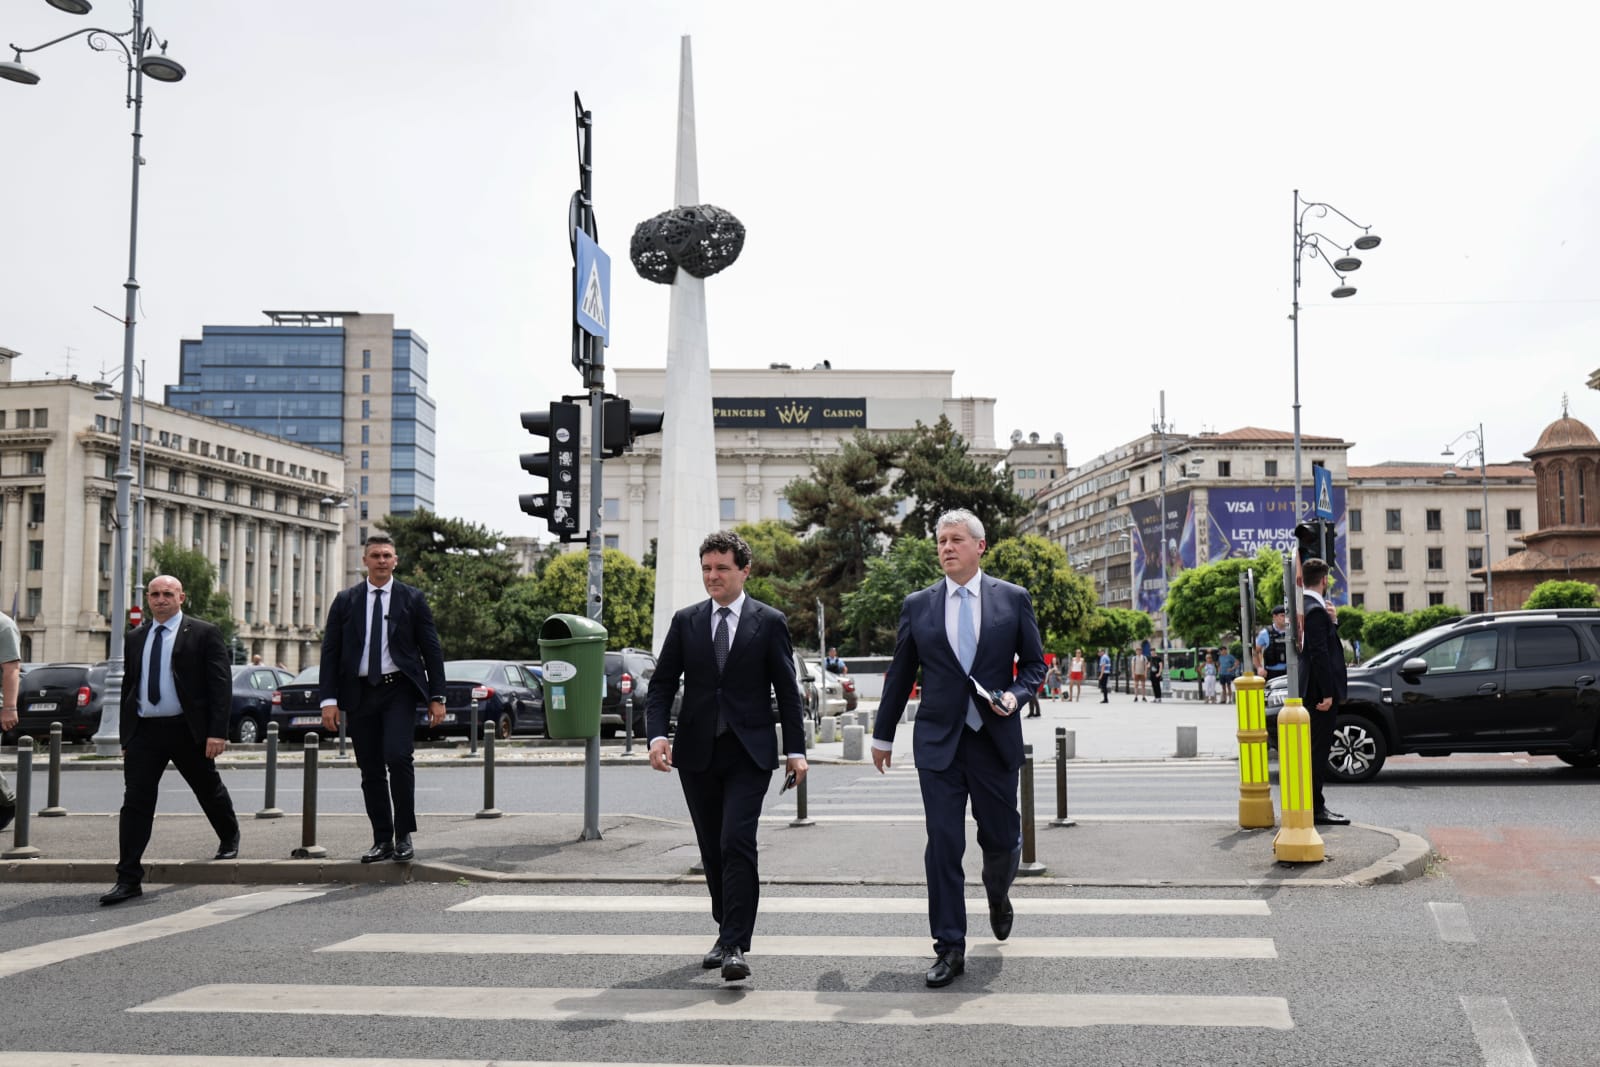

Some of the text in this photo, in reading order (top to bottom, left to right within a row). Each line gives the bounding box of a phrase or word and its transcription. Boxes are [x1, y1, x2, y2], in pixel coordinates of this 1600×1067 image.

[713, 408, 863, 417] PRINCESS CASINO
[1225, 501, 1255, 512] VISA
[1231, 528, 1296, 540] LET MUSIC
[1275, 541, 1297, 552] OV
